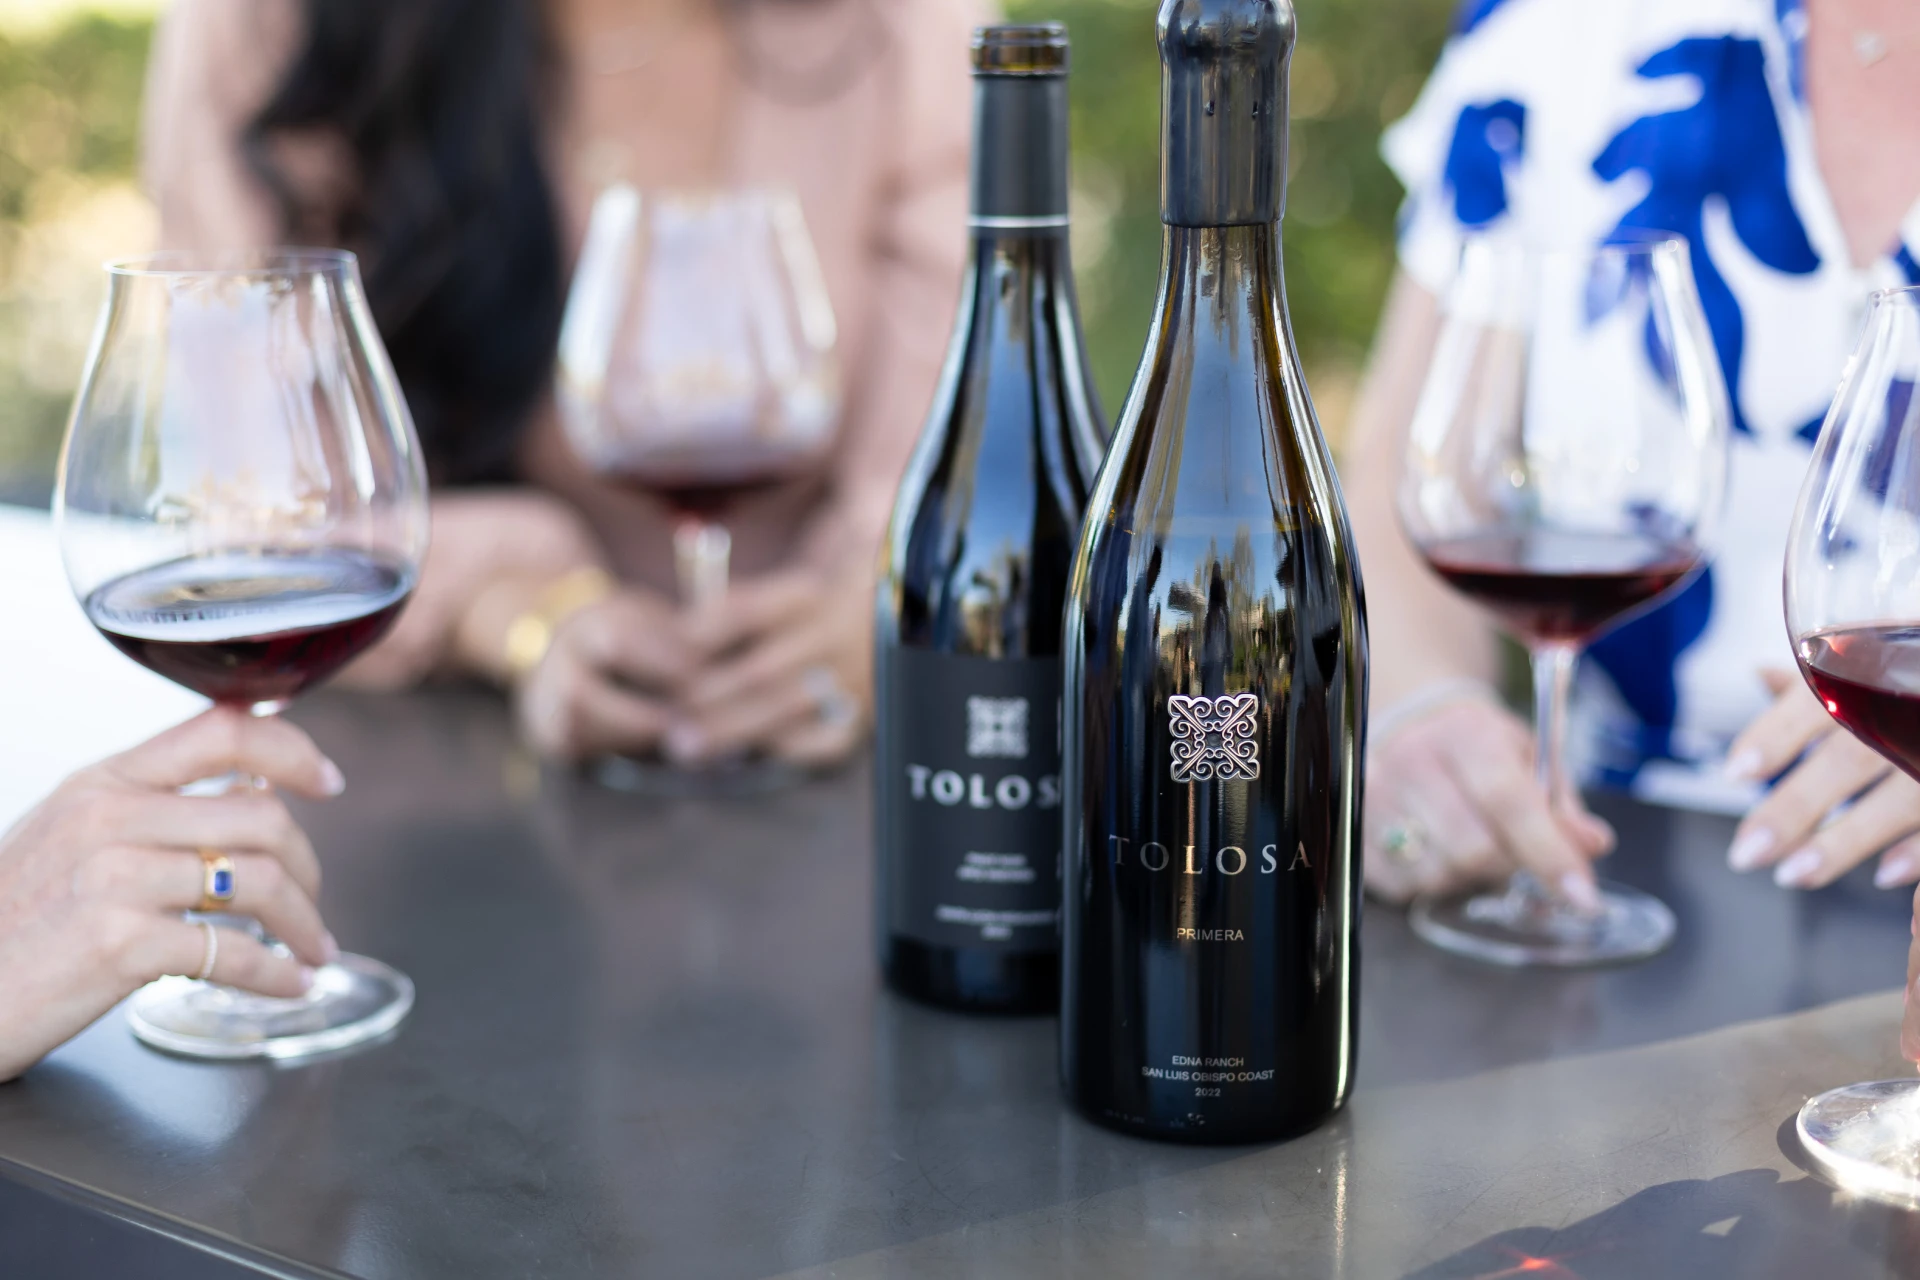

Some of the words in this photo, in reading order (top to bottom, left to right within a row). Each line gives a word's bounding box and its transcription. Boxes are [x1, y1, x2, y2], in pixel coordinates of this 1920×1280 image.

[905, 763, 1060, 811] TOLOS
[1108, 833, 1313, 876] TOLOSA
[1176, 926, 1245, 941] PRIMERA
[1171, 1055, 1202, 1067] EDNA
[1204, 1057, 1244, 1067] RANCH
[1142, 1066, 1163, 1079] SAN
[1165, 1069, 1190, 1081] LUIS
[1191, 1071, 1236, 1082] OBISPO
[1237, 1069, 1275, 1081] COAST
[1194, 1087, 1221, 1097] 2022
